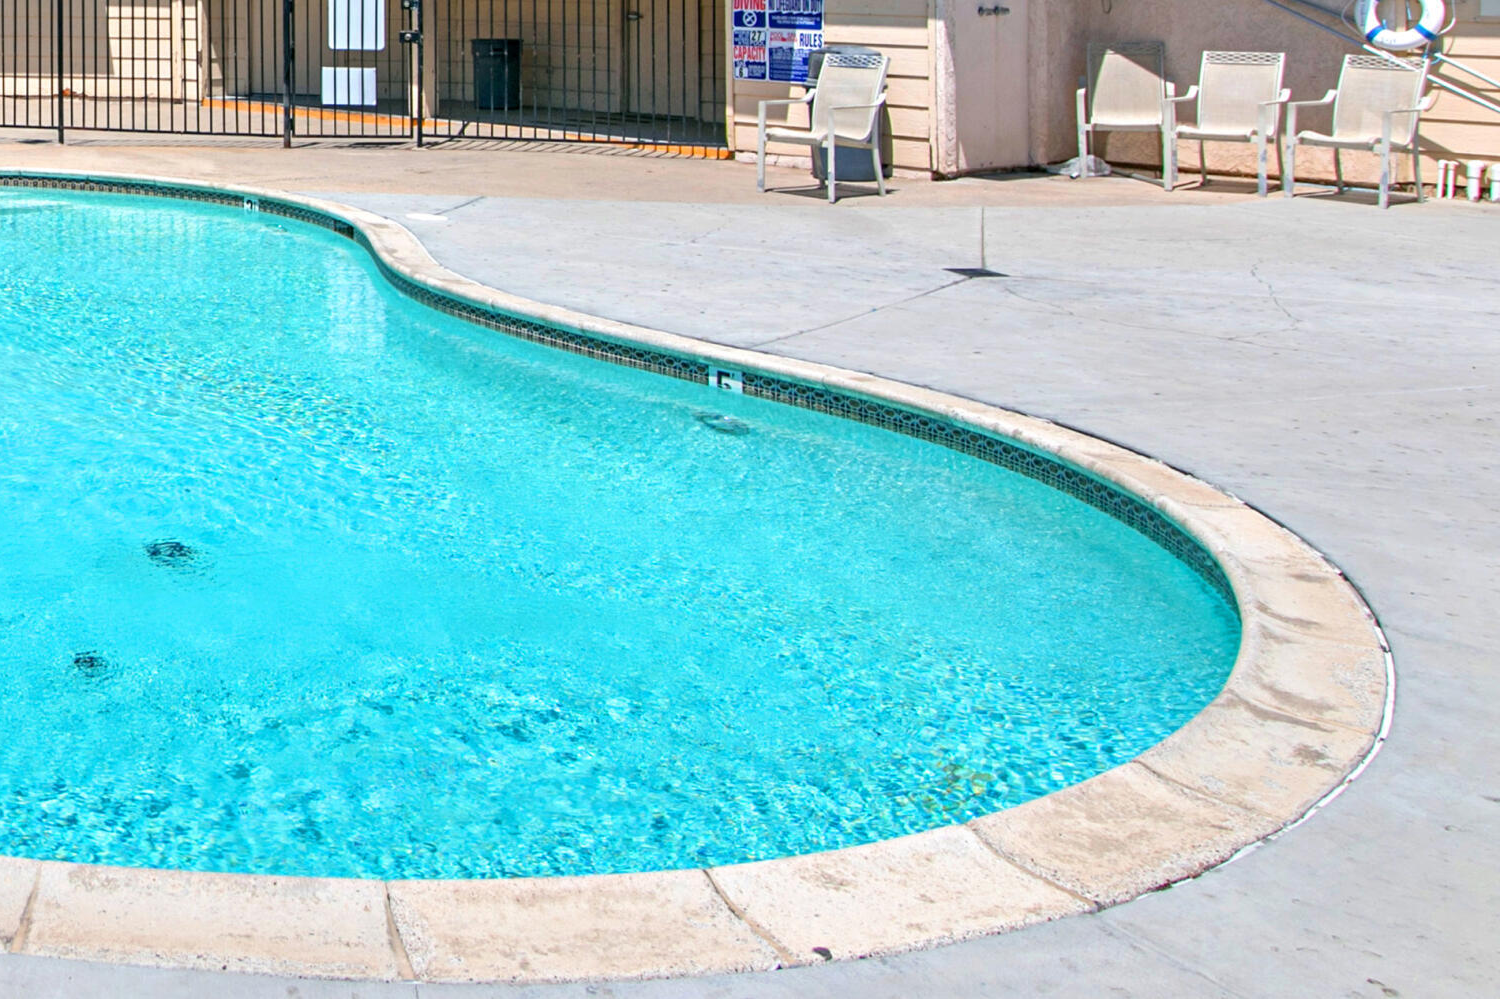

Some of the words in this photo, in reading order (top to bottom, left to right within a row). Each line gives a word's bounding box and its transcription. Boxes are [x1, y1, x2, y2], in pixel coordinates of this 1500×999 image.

[751, 30, 762, 41] 27
[799, 32, 823, 48] RULES
[733, 45, 765, 61] CAPACITY
